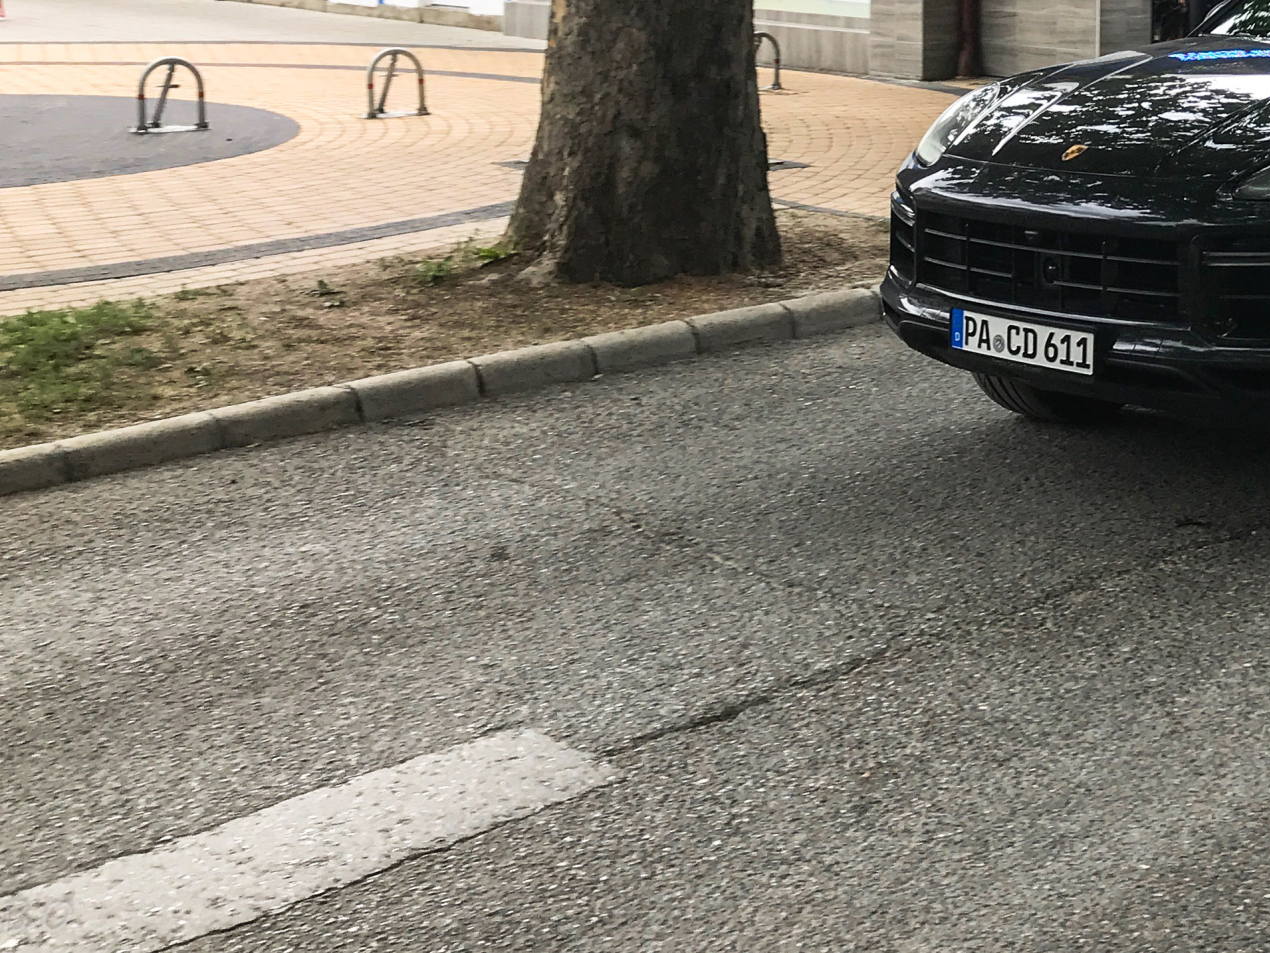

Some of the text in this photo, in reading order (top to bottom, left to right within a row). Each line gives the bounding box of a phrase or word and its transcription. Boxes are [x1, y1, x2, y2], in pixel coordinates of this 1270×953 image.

[964, 315, 1091, 370] PA CD 611
